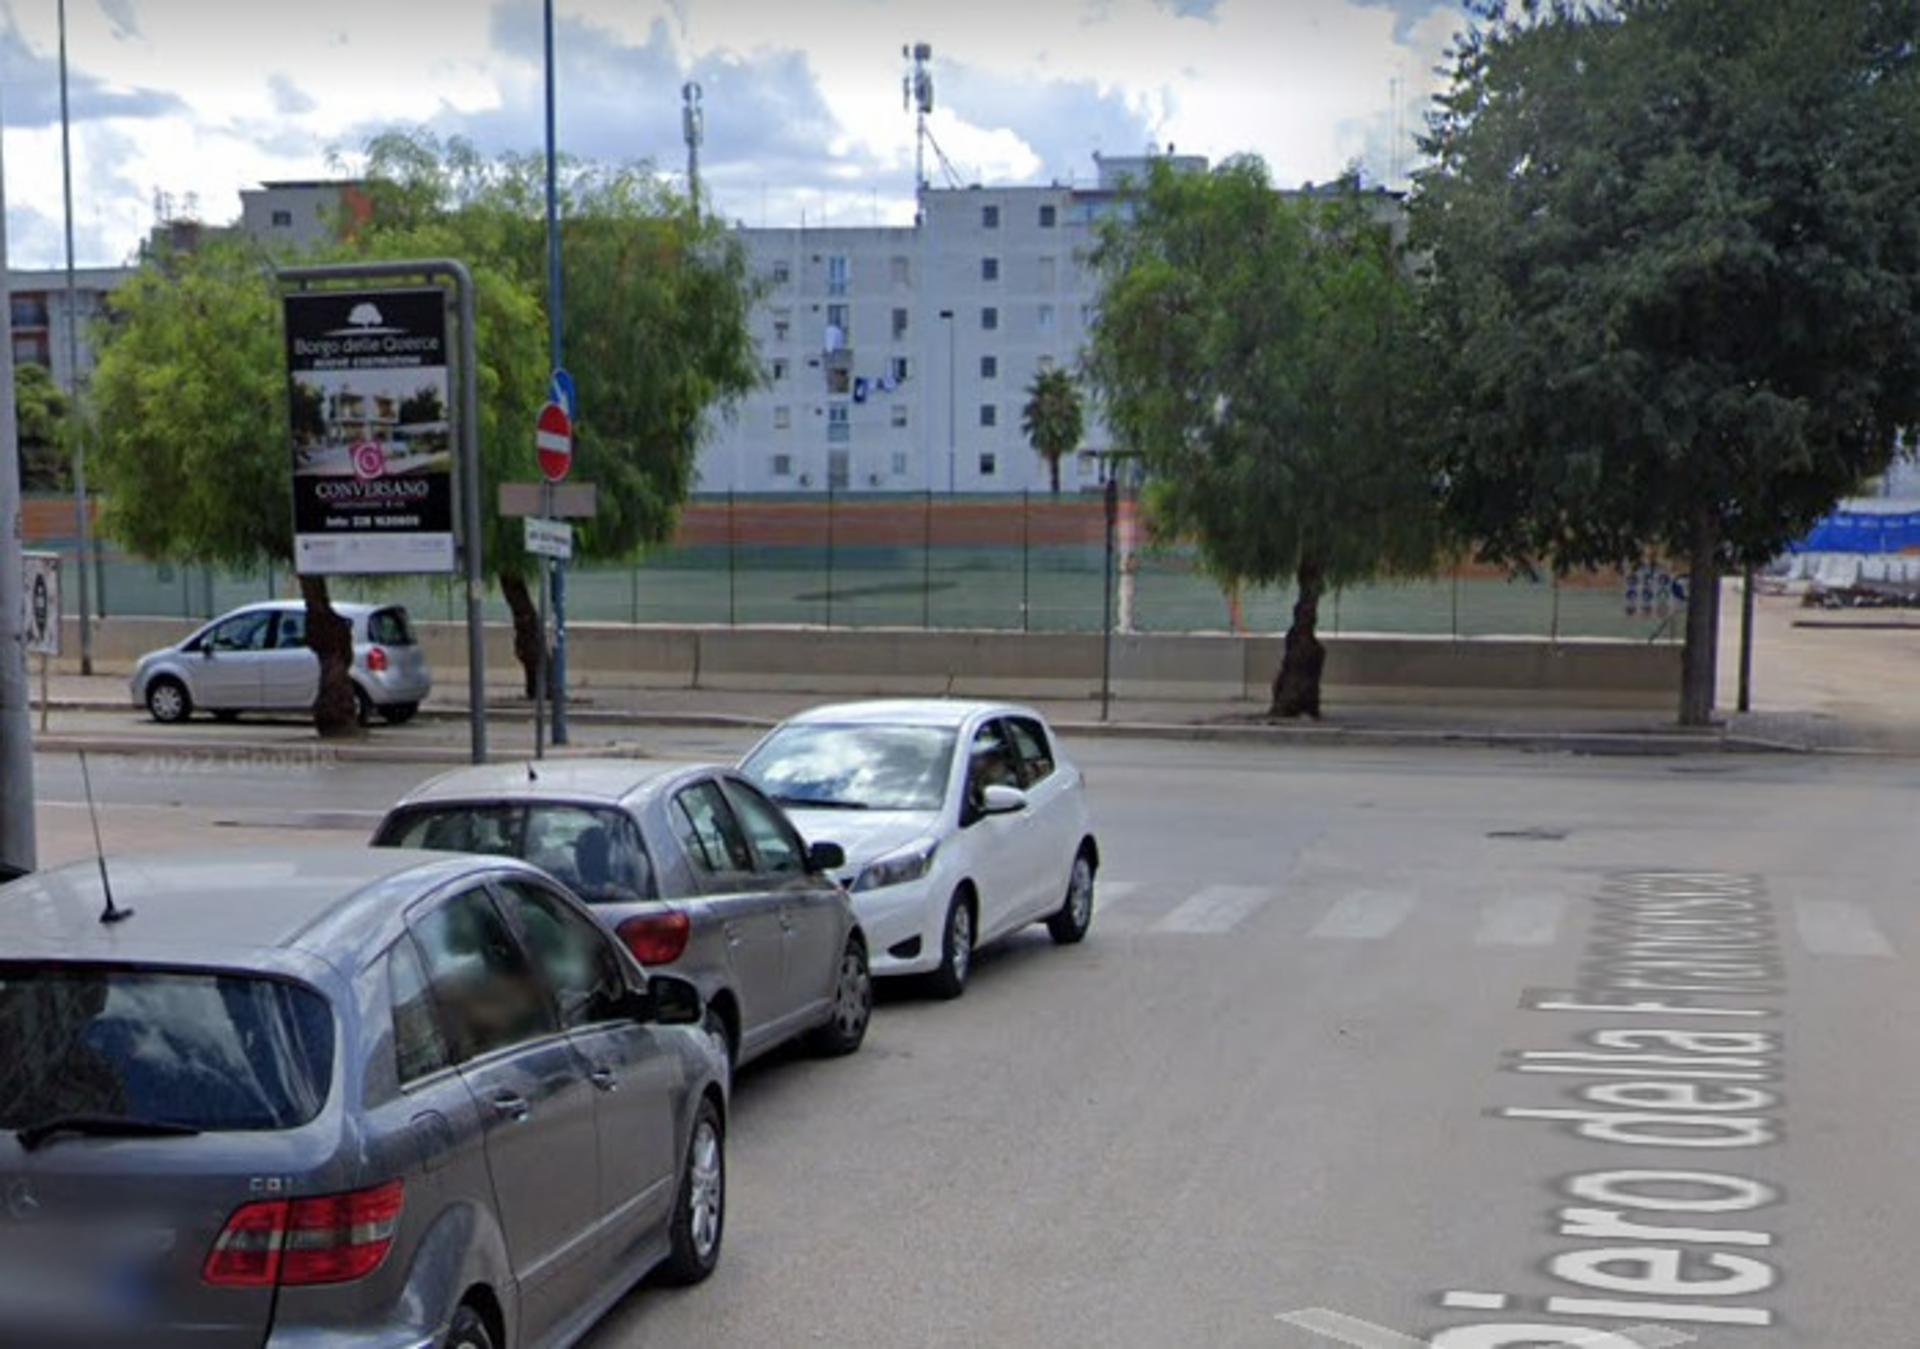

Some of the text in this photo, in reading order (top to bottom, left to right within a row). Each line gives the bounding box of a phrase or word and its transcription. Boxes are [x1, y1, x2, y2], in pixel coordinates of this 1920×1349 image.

[295, 335, 439, 359] Borgo delle Querce
[315, 479, 429, 498] CONVERSANO
